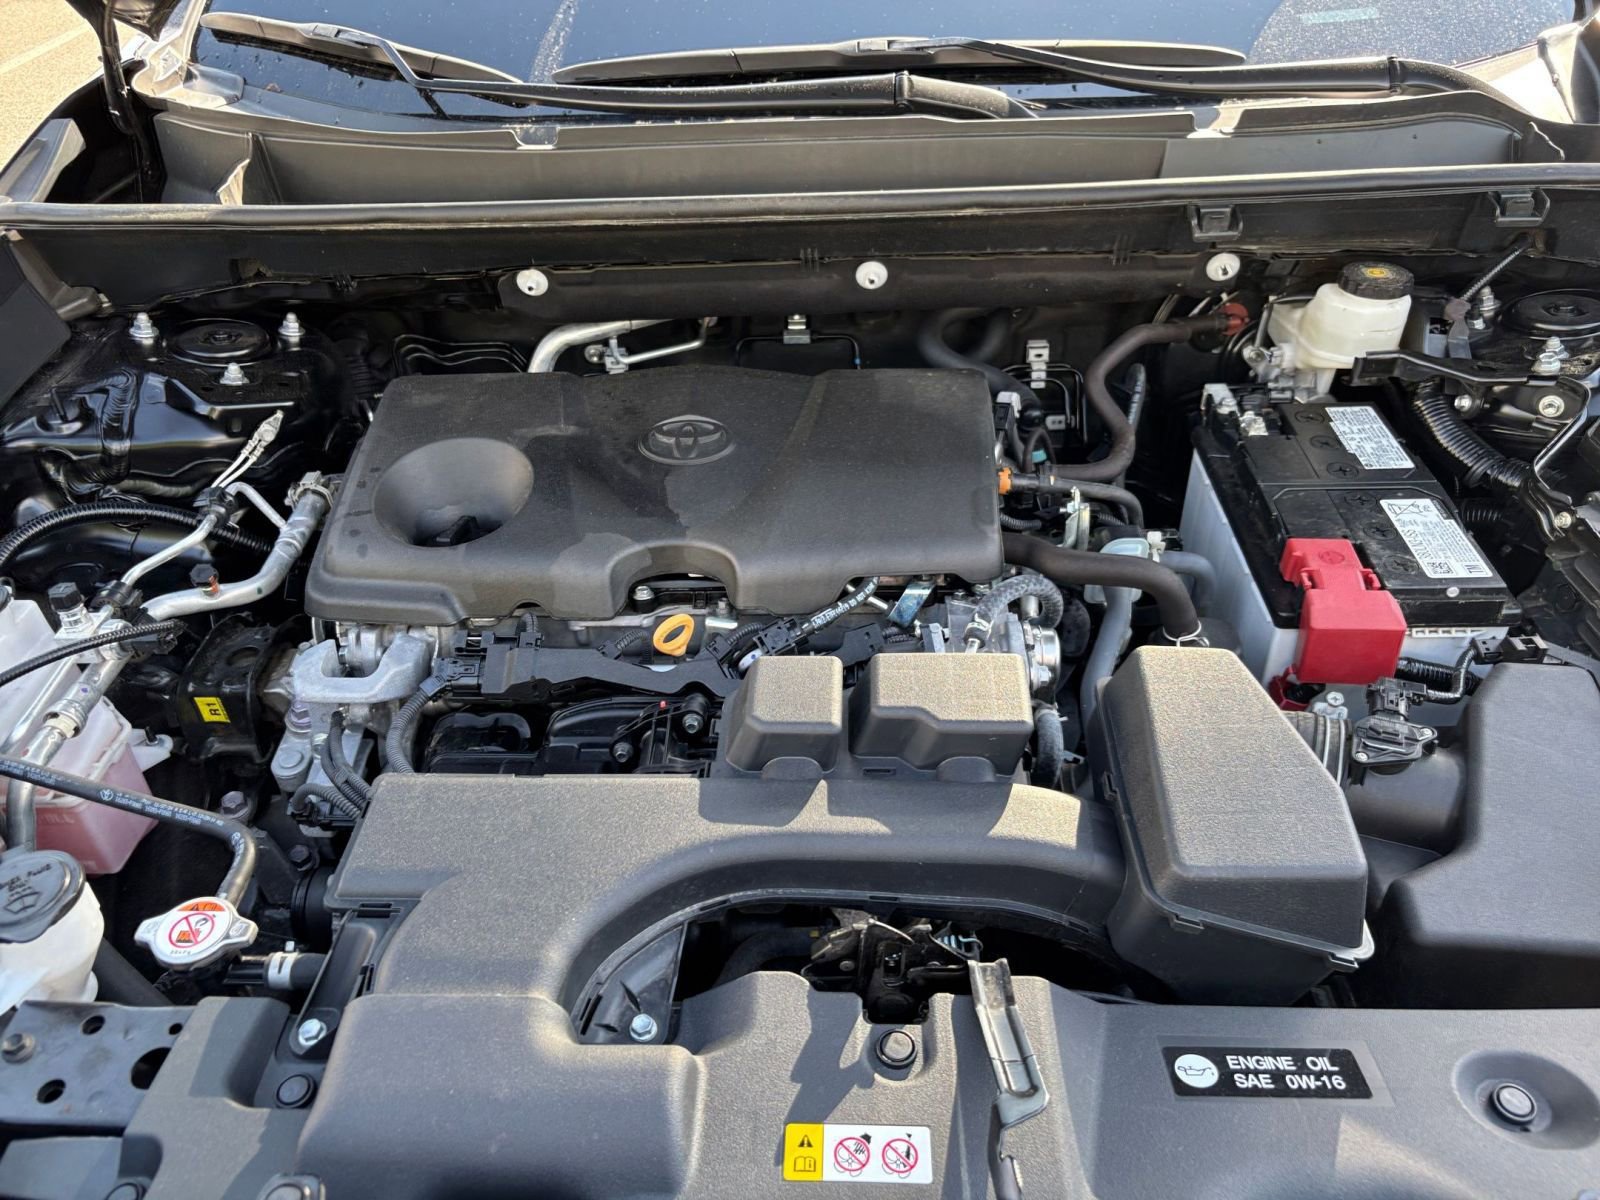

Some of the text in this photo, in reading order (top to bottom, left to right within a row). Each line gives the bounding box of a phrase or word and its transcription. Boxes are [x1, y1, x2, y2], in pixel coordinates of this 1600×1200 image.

[206, 703, 221, 716] R1
[1226, 1055, 1339, 1071] ENGINE OIL
[1234, 1074, 1346, 1090] SAE 0W-16
